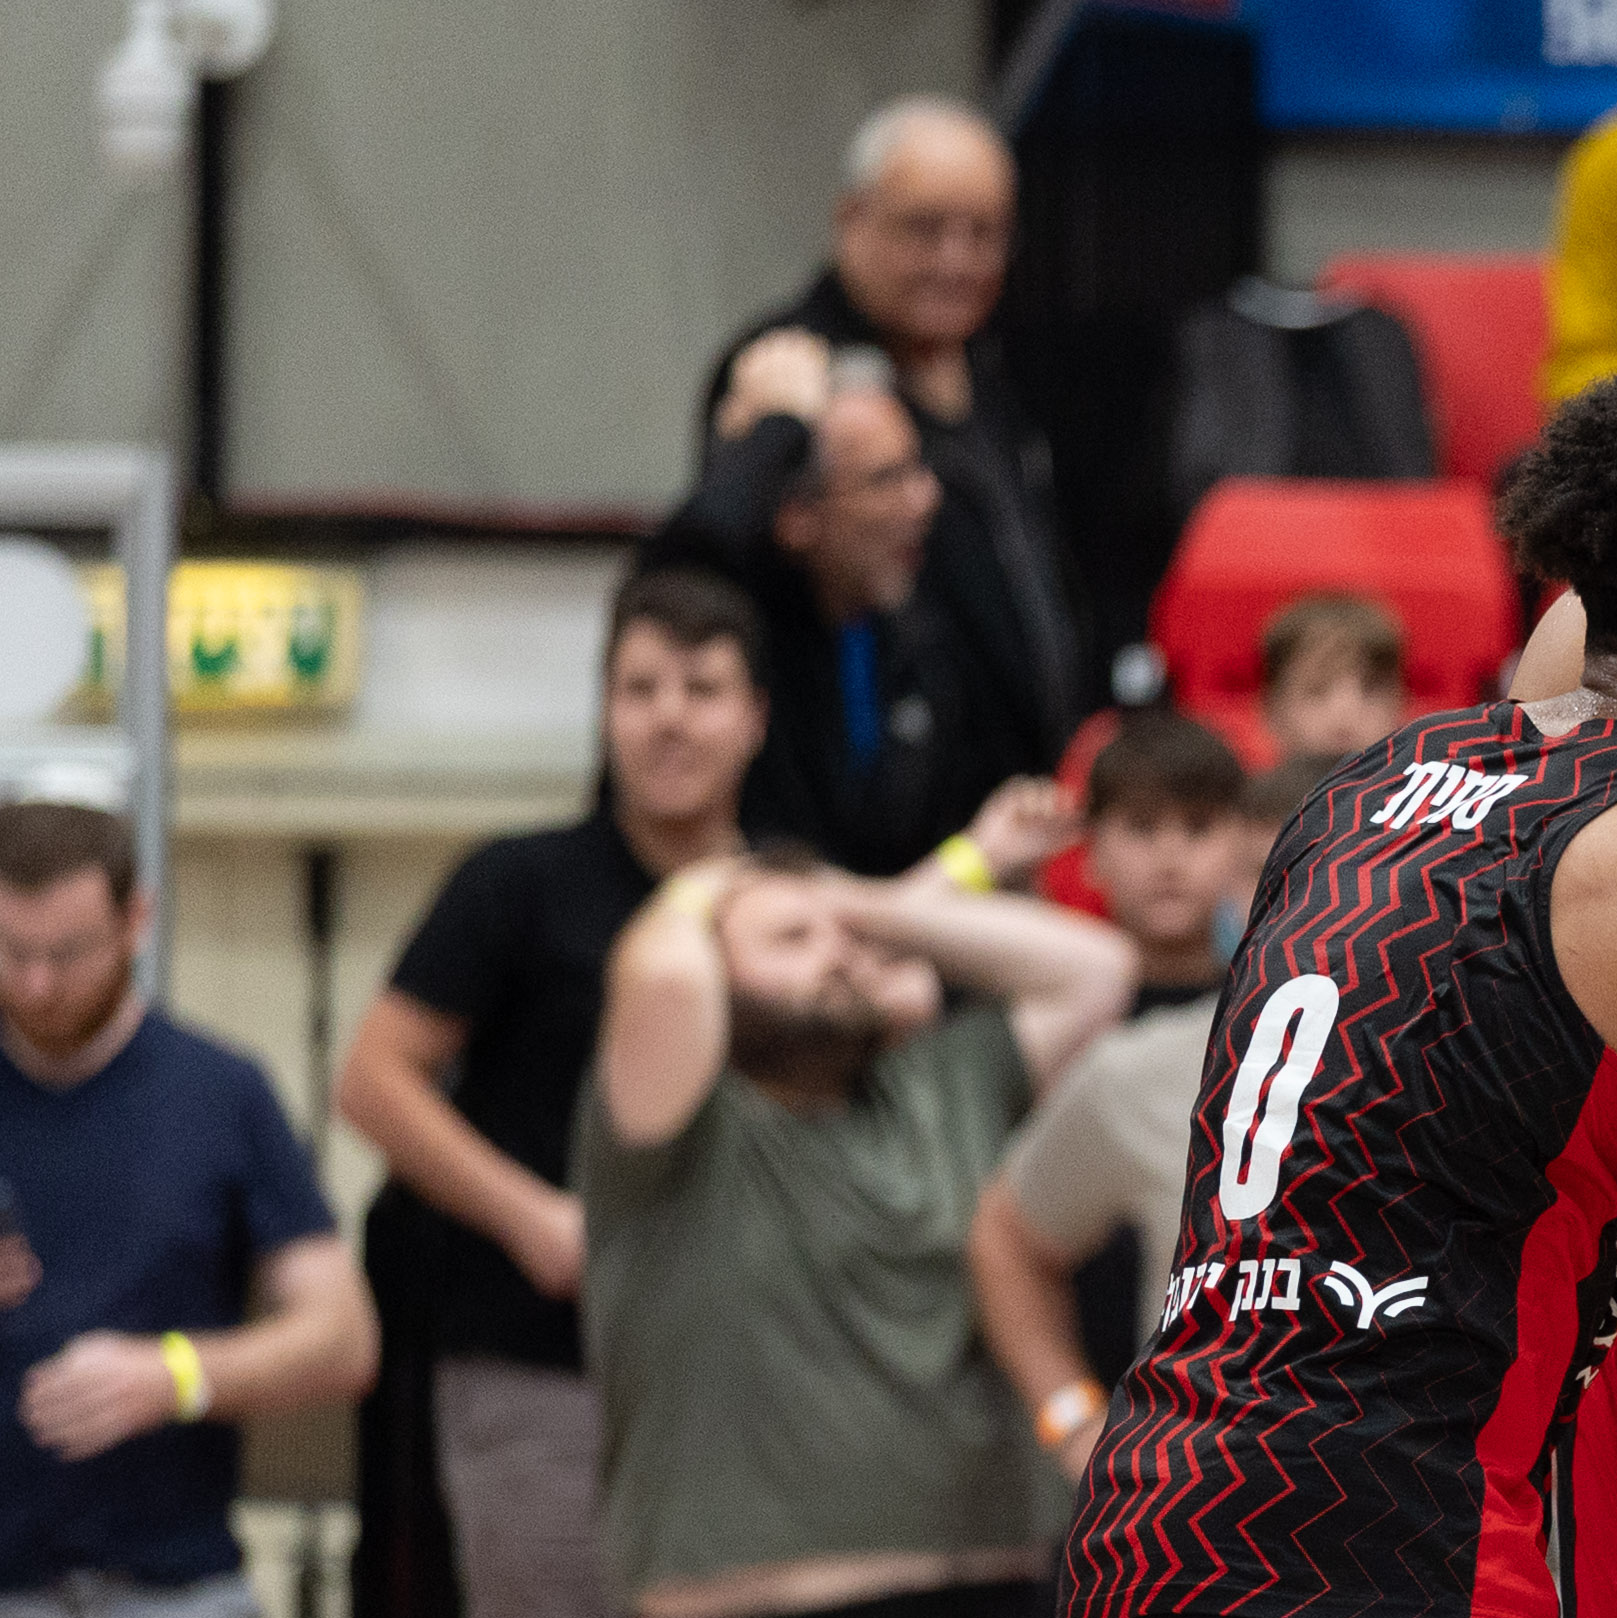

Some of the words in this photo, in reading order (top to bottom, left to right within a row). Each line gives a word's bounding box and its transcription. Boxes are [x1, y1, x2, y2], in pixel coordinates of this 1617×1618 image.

[1370, 761, 1529, 829] סמית
[1219, 974, 1339, 1220] 0
[1229, 1259, 1301, 1322] בנק
